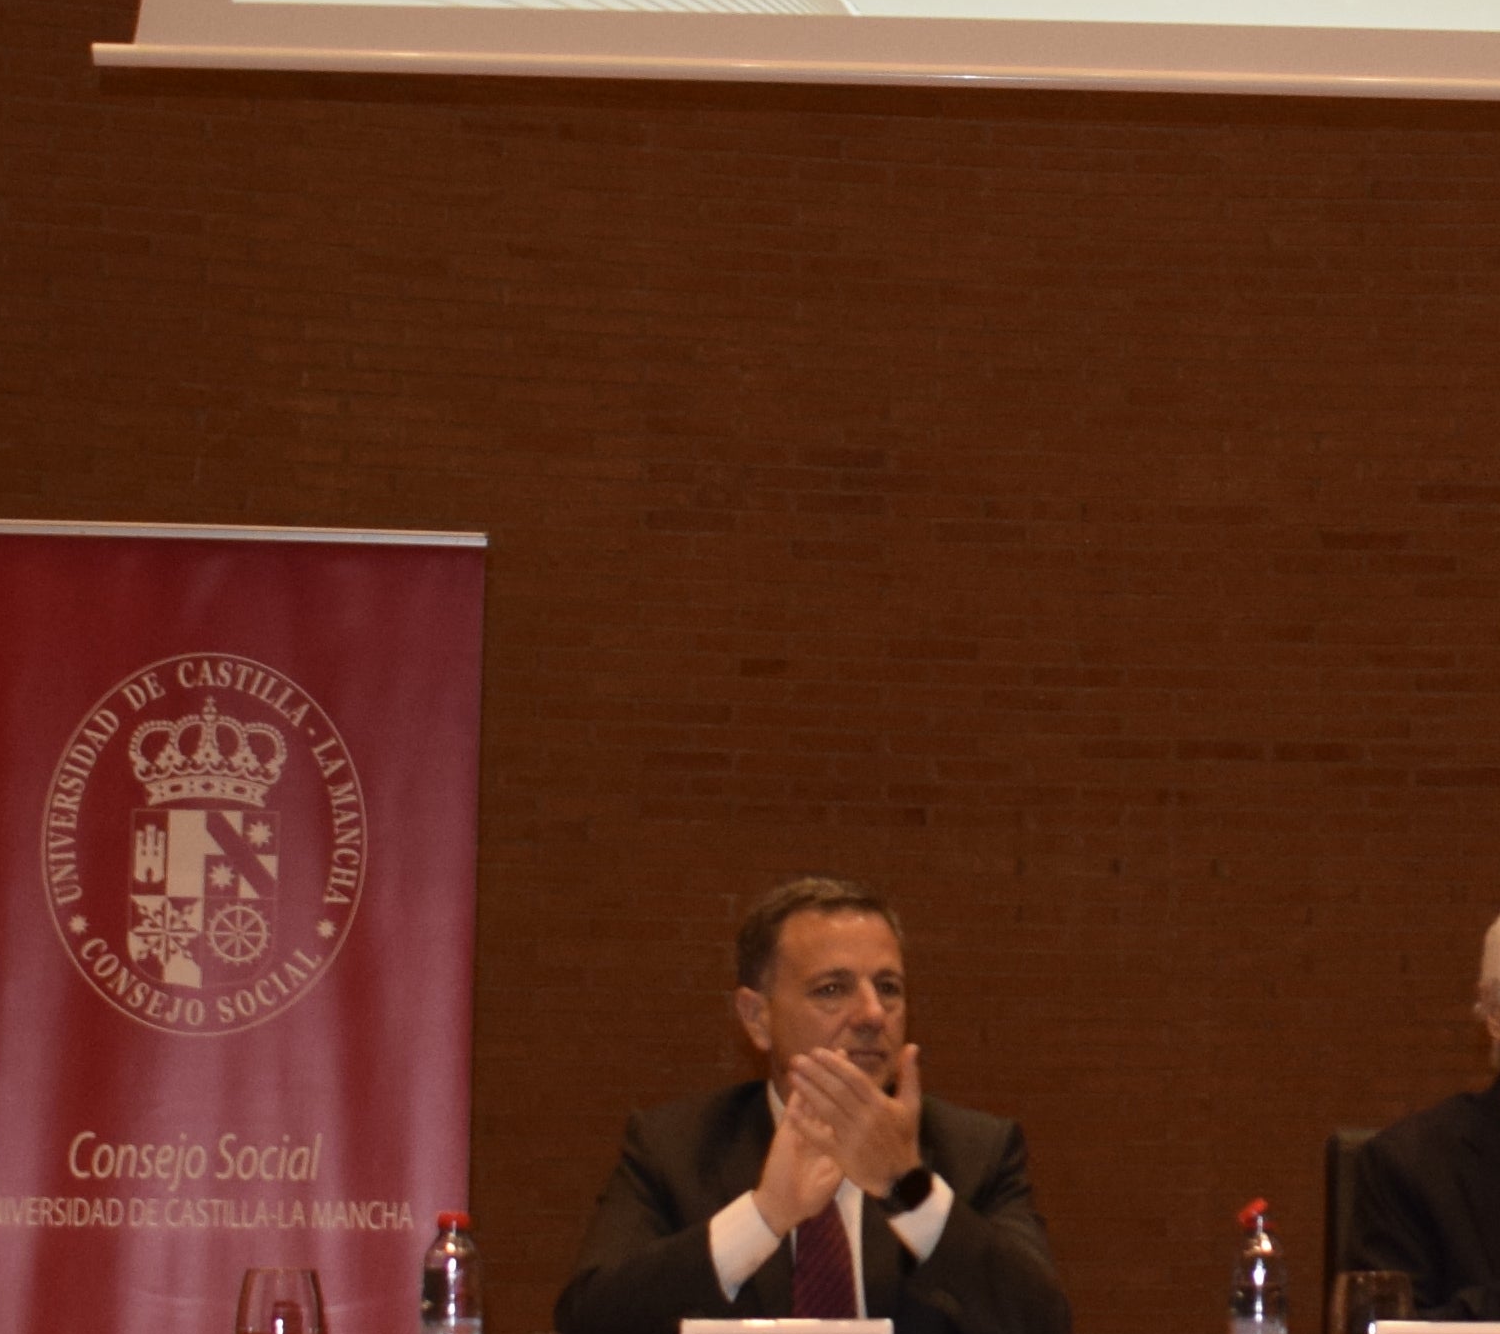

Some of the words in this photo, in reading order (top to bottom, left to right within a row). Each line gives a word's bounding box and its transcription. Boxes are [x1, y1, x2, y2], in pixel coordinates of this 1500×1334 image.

[49, 708, 120, 906] UNIVERSIDAD
[121, 672, 167, 711] DE
[323, 781, 362, 904] MANCHA
[81, 938, 205, 1026] CONSEJO
[216, 949, 323, 1023] SOCIAL
[68, 1130, 207, 1192] Consejo
[214, 1132, 323, 1181] Social
[129, 1198, 159, 1227] DE
[164, 1198, 307, 1228] CASTILLA-LA
[311, 1200, 415, 1230] MANCHA
